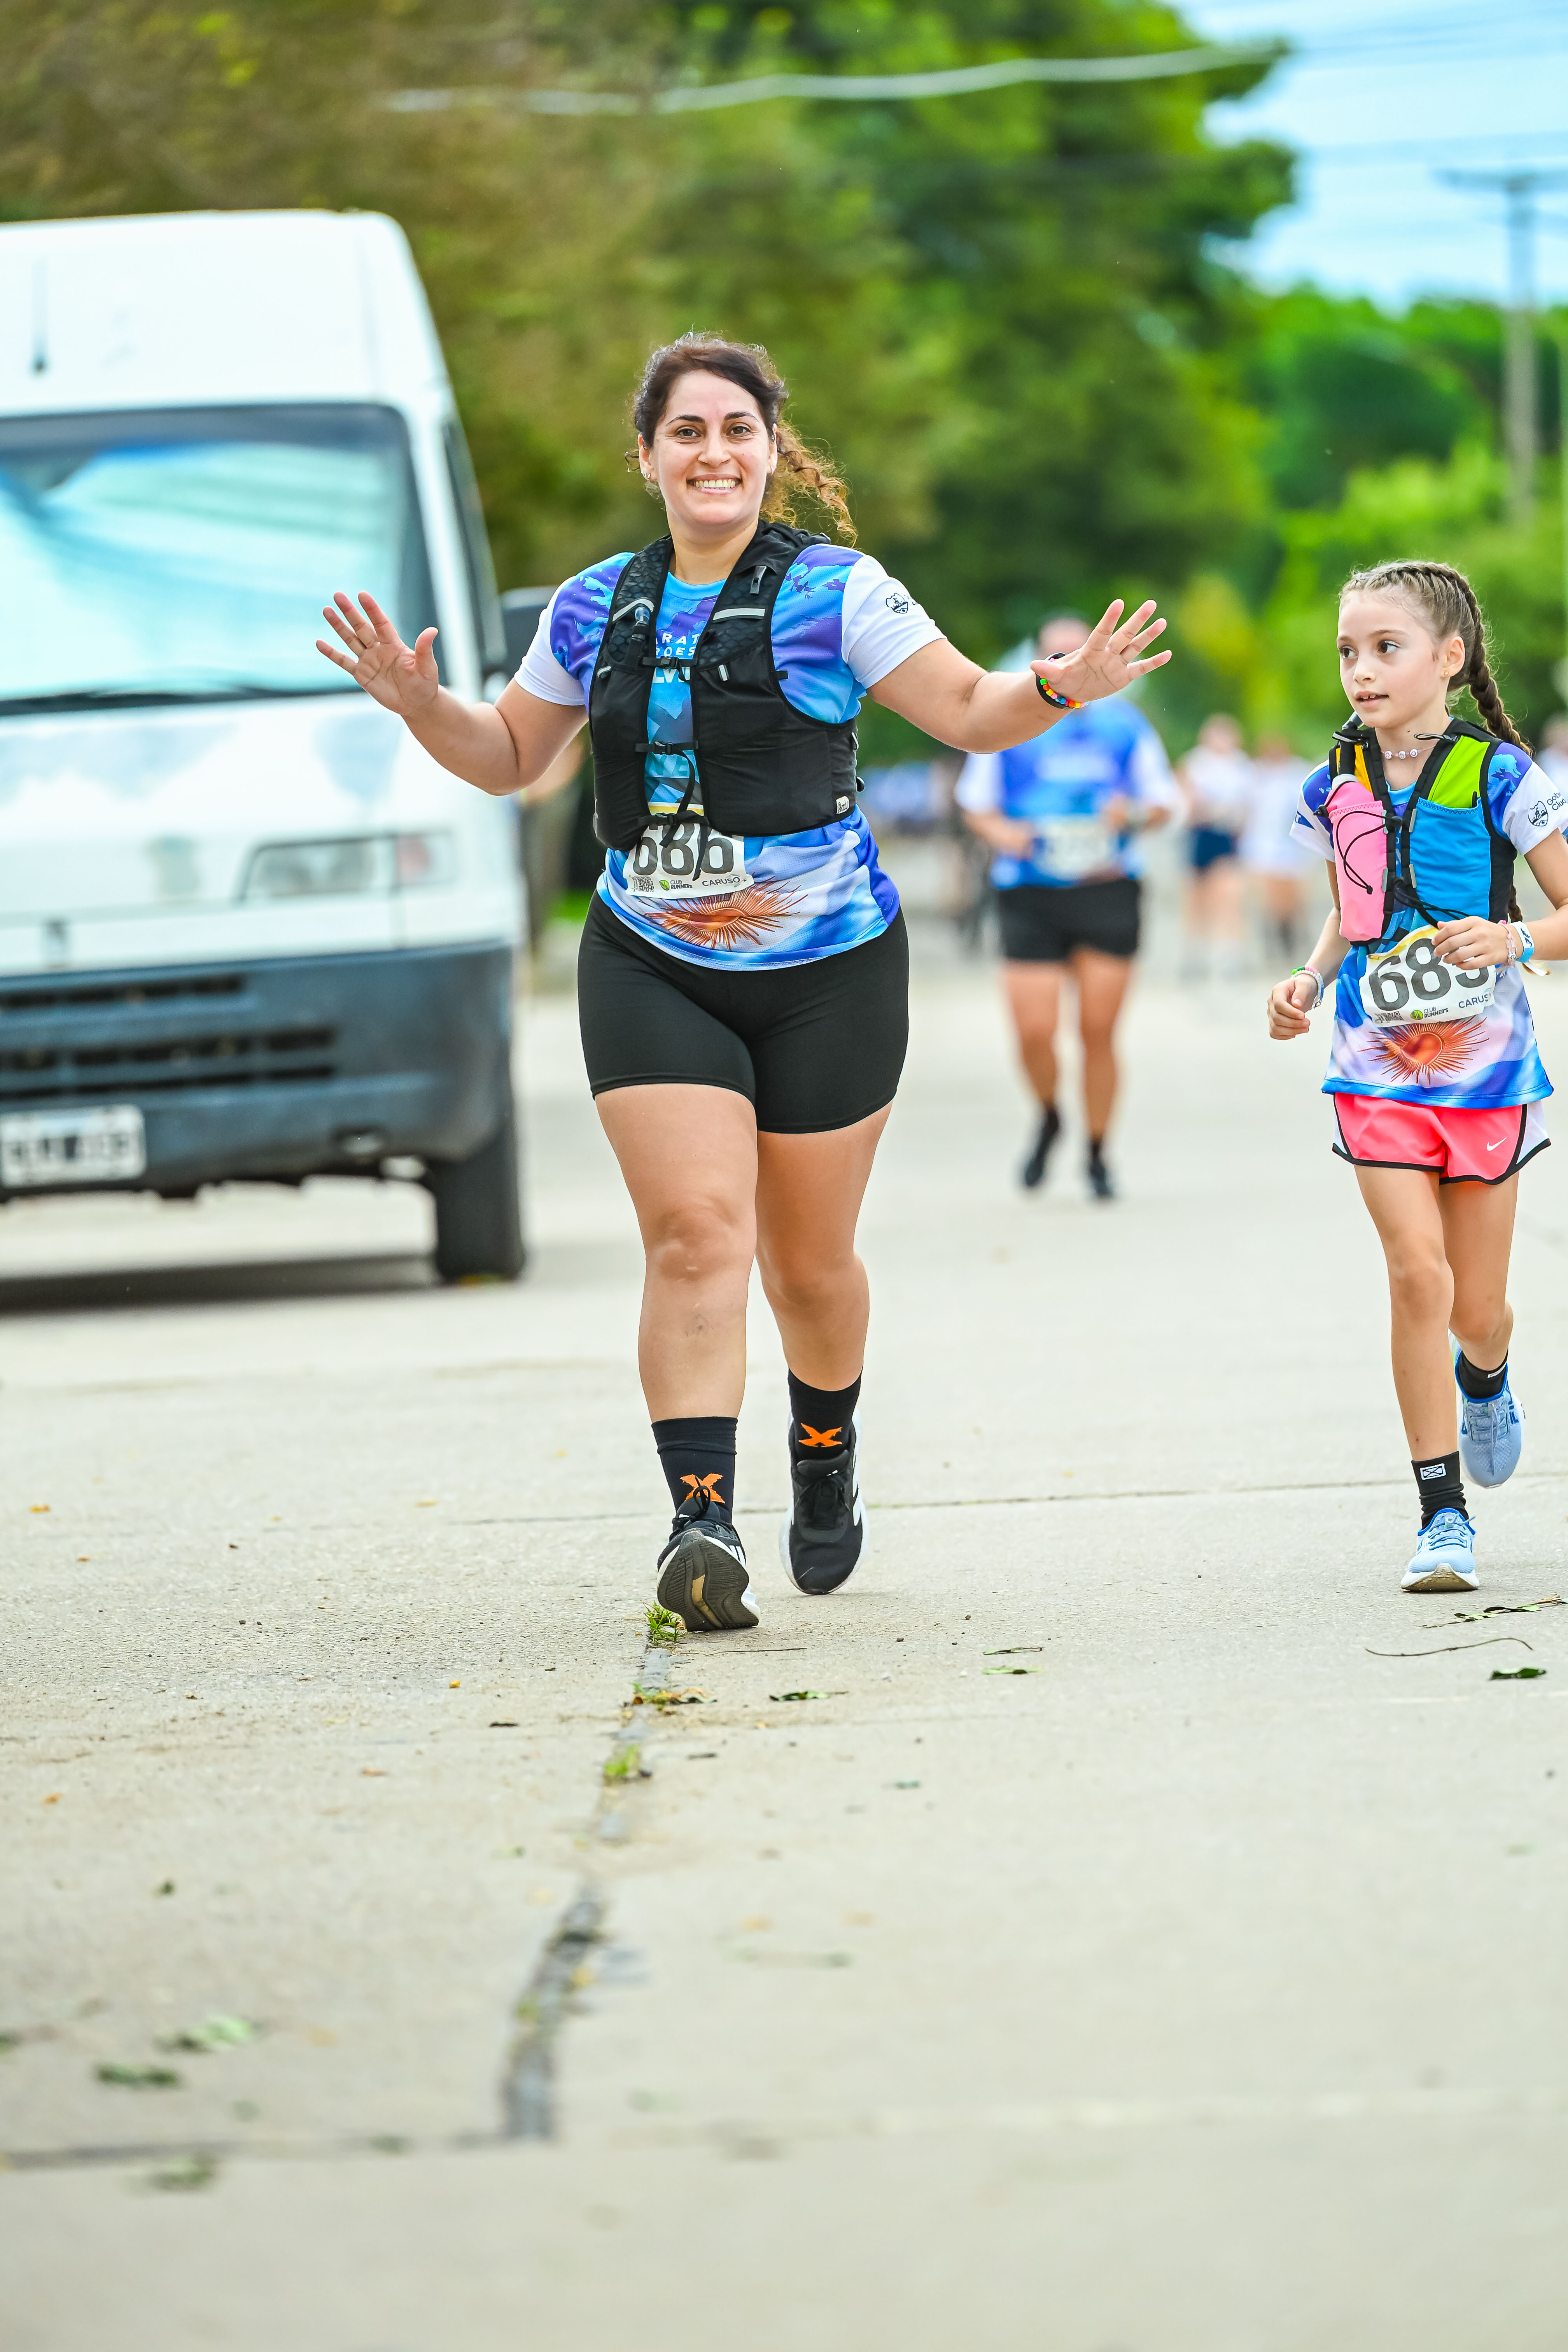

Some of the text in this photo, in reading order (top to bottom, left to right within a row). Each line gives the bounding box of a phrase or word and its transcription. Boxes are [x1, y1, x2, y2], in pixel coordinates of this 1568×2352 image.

[656, 633, 700, 645] RAT
[1547, 792, 1561, 805] Gob
[702, 877, 740, 886] CARUSO
